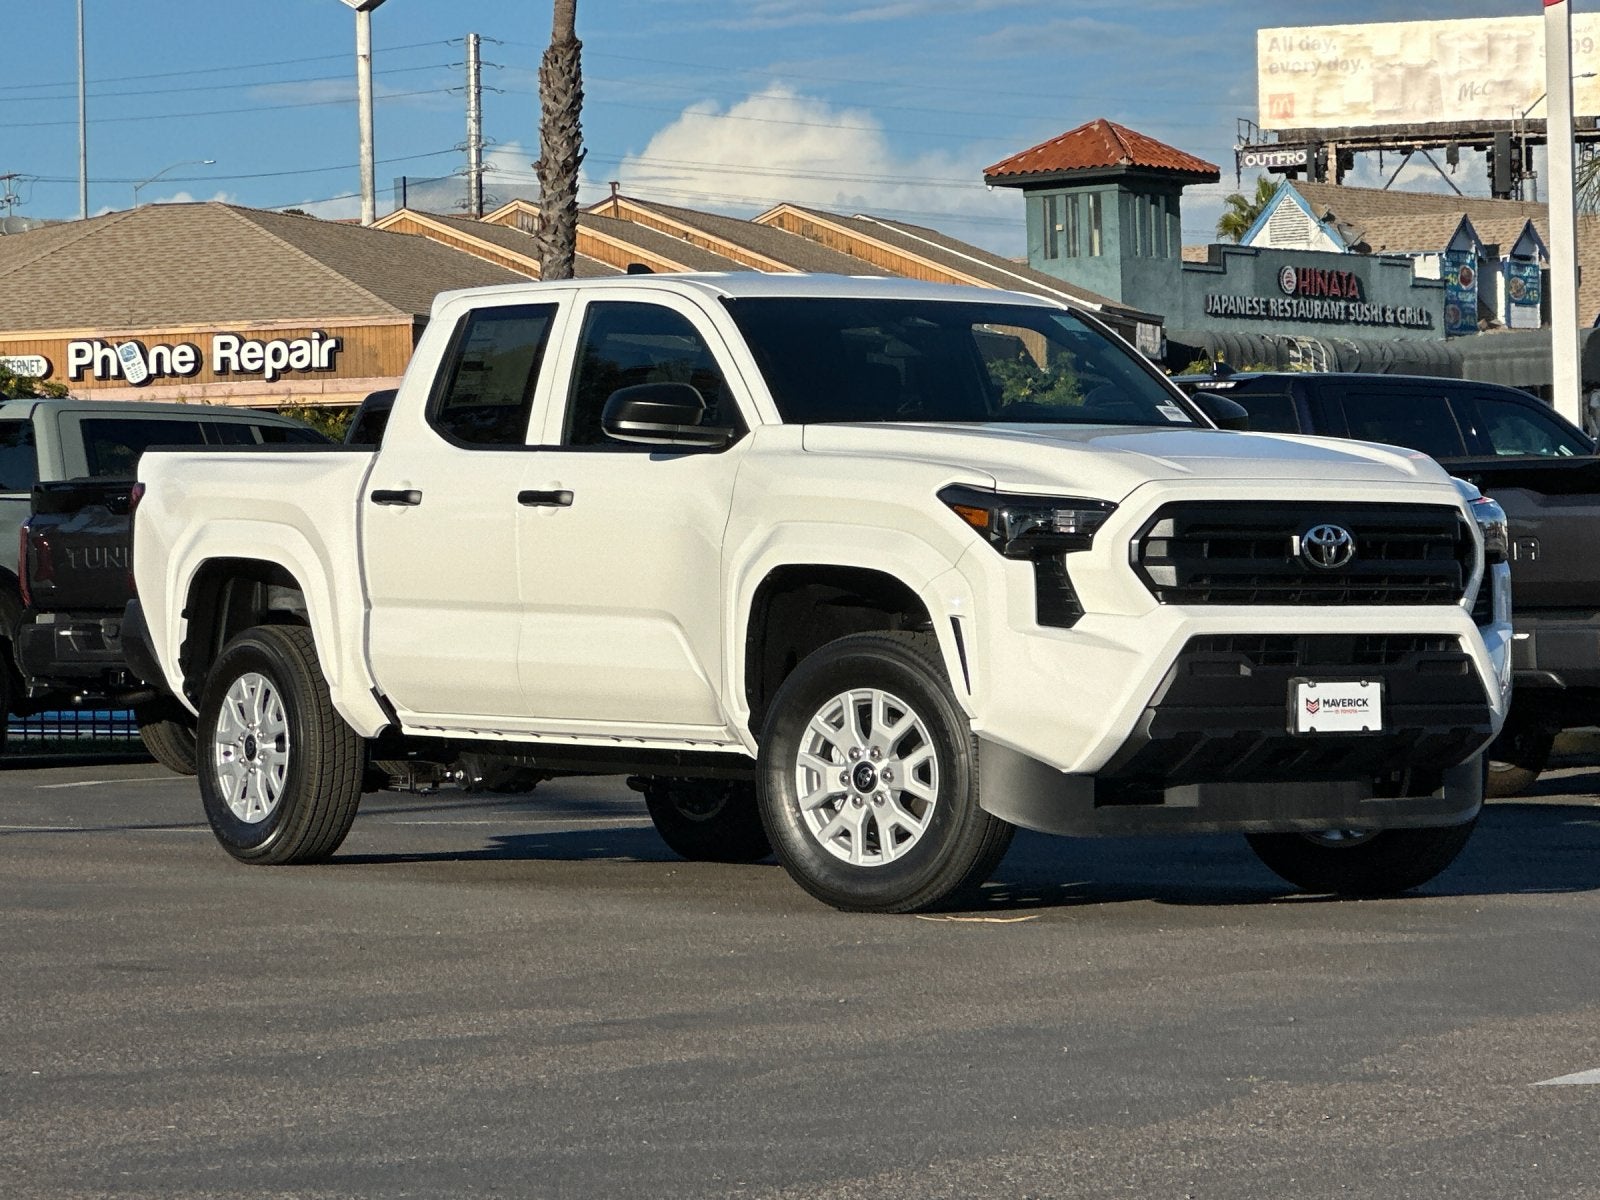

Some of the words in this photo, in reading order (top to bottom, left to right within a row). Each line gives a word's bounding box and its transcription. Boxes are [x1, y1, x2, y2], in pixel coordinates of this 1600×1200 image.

[1267, 36, 1293, 52] All
[1268, 59, 1321, 77] every
[1298, 267, 1360, 299] HINATA
[1206, 294, 1267, 315] JAPANESE
[1270, 298, 1346, 320] RESTAURANT
[1349, 302, 1384, 322] SUSHI
[1385, 305, 1395, 324] &
[1397, 306, 1430, 325] GRILL
[212, 331, 338, 379] Repair
[1322, 698, 1369, 708] MAVERICK
